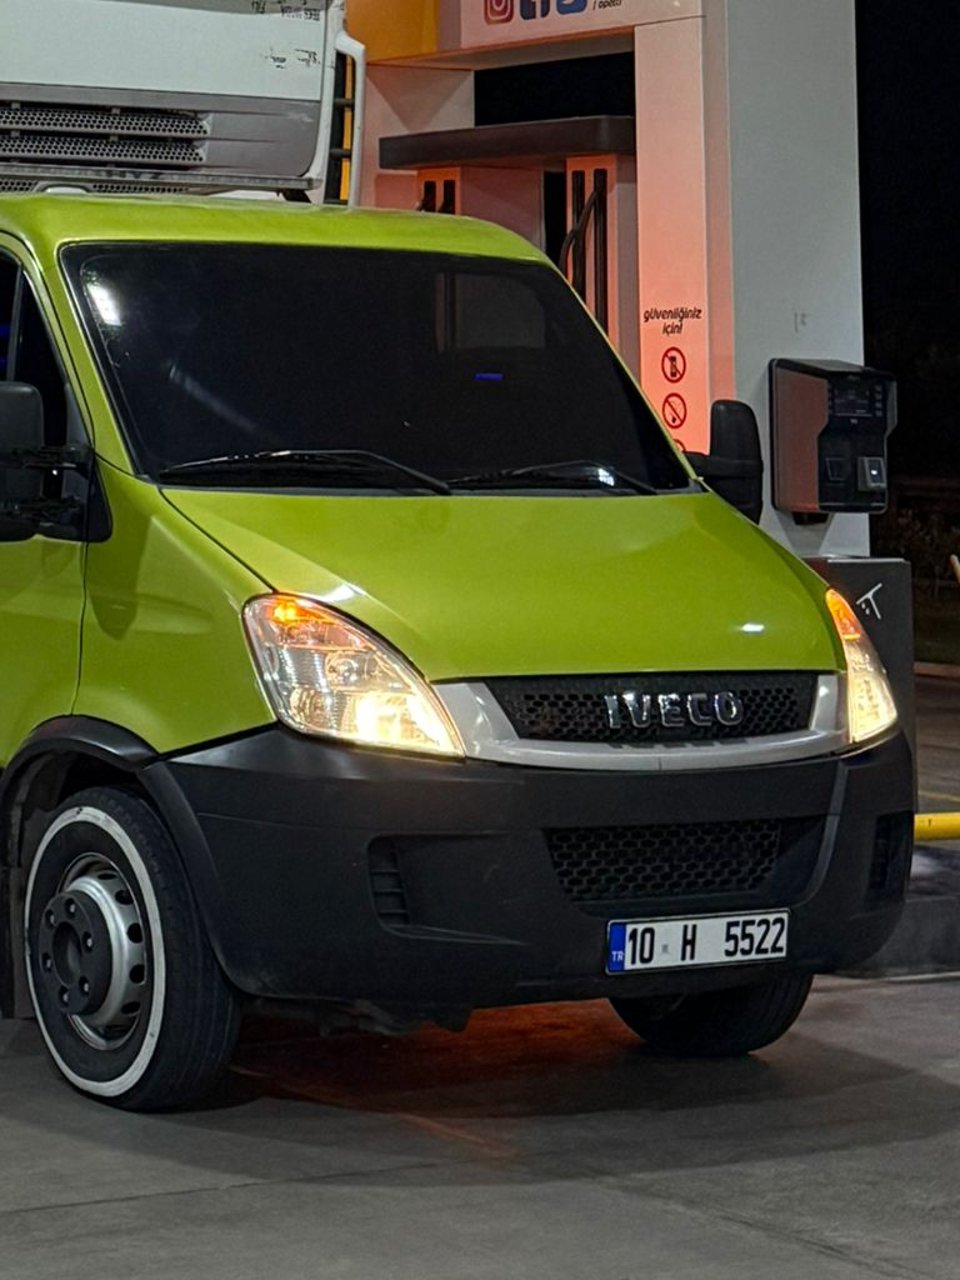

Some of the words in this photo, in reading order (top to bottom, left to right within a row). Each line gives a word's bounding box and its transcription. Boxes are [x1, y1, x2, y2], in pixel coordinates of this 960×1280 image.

[604, 691, 744, 729] IVECO
[628, 926, 656, 966] 10
[680, 923, 703, 962] H
[724, 916, 787, 958] 5522
